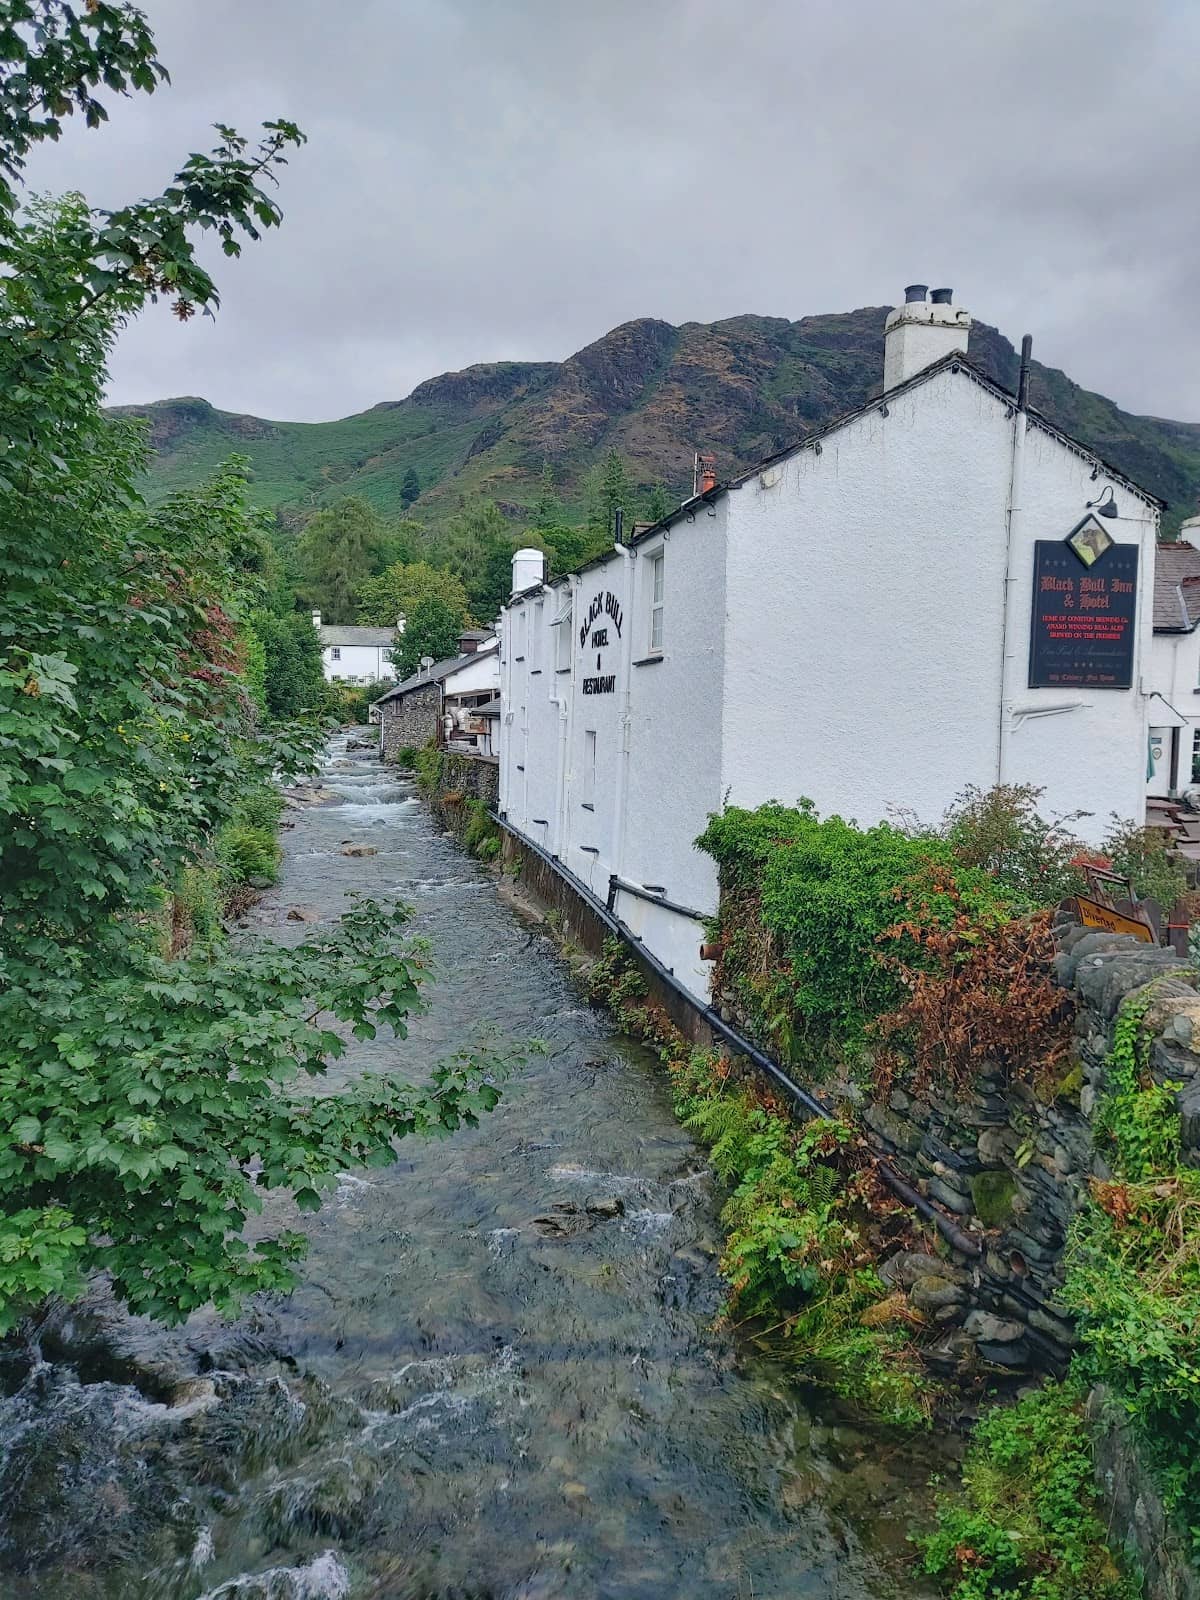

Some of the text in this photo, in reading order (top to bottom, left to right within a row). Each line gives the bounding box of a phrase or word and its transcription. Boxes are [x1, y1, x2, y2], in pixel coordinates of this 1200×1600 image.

[1041, 577, 1133, 593] Black Bull Inn
[1063, 594, 1110, 610] & Hotel
[580, 591, 623, 648] BLACK BULL
[591, 628, 609, 648] HOTEL
[582, 675, 616, 695] RESTAURANT
[1082, 906, 1116, 931] Diverted
